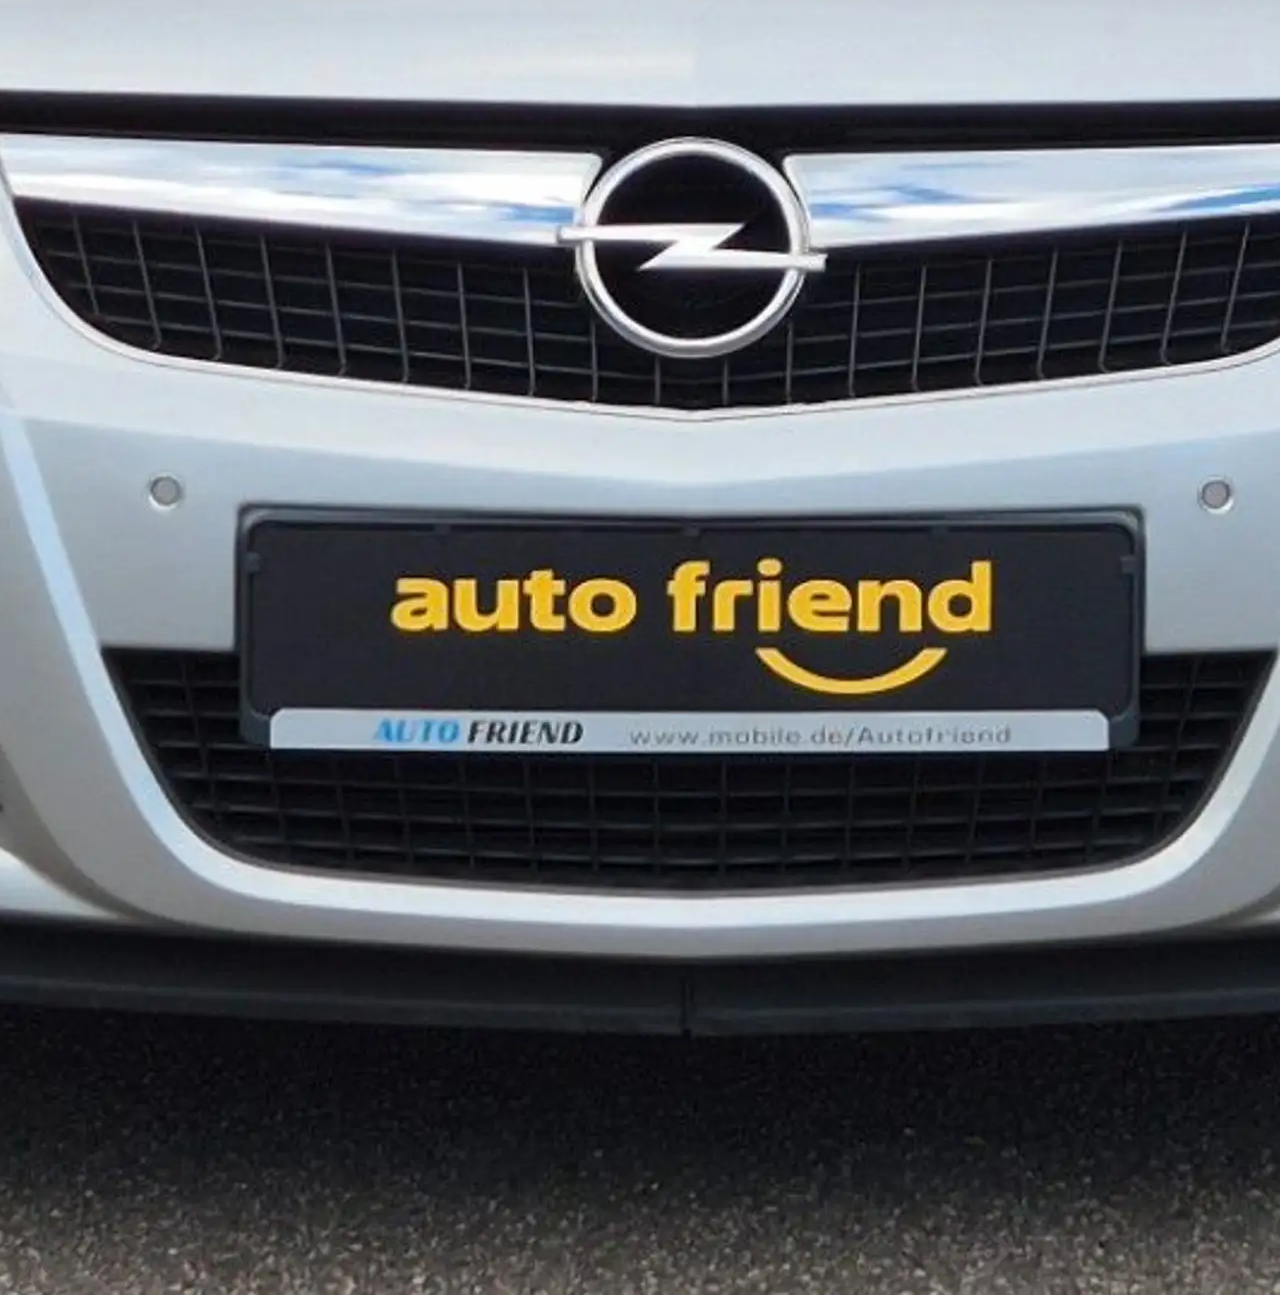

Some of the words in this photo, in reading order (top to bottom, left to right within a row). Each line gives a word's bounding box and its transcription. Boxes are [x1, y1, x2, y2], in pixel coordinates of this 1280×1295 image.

[391, 568, 635, 632] auto
[667, 559, 994, 632] friend
[375, 719, 459, 743] AUTO
[467, 720, 584, 745] FRIEND
[629, 725, 1012, 747] www.mobile.de/Autofriend
